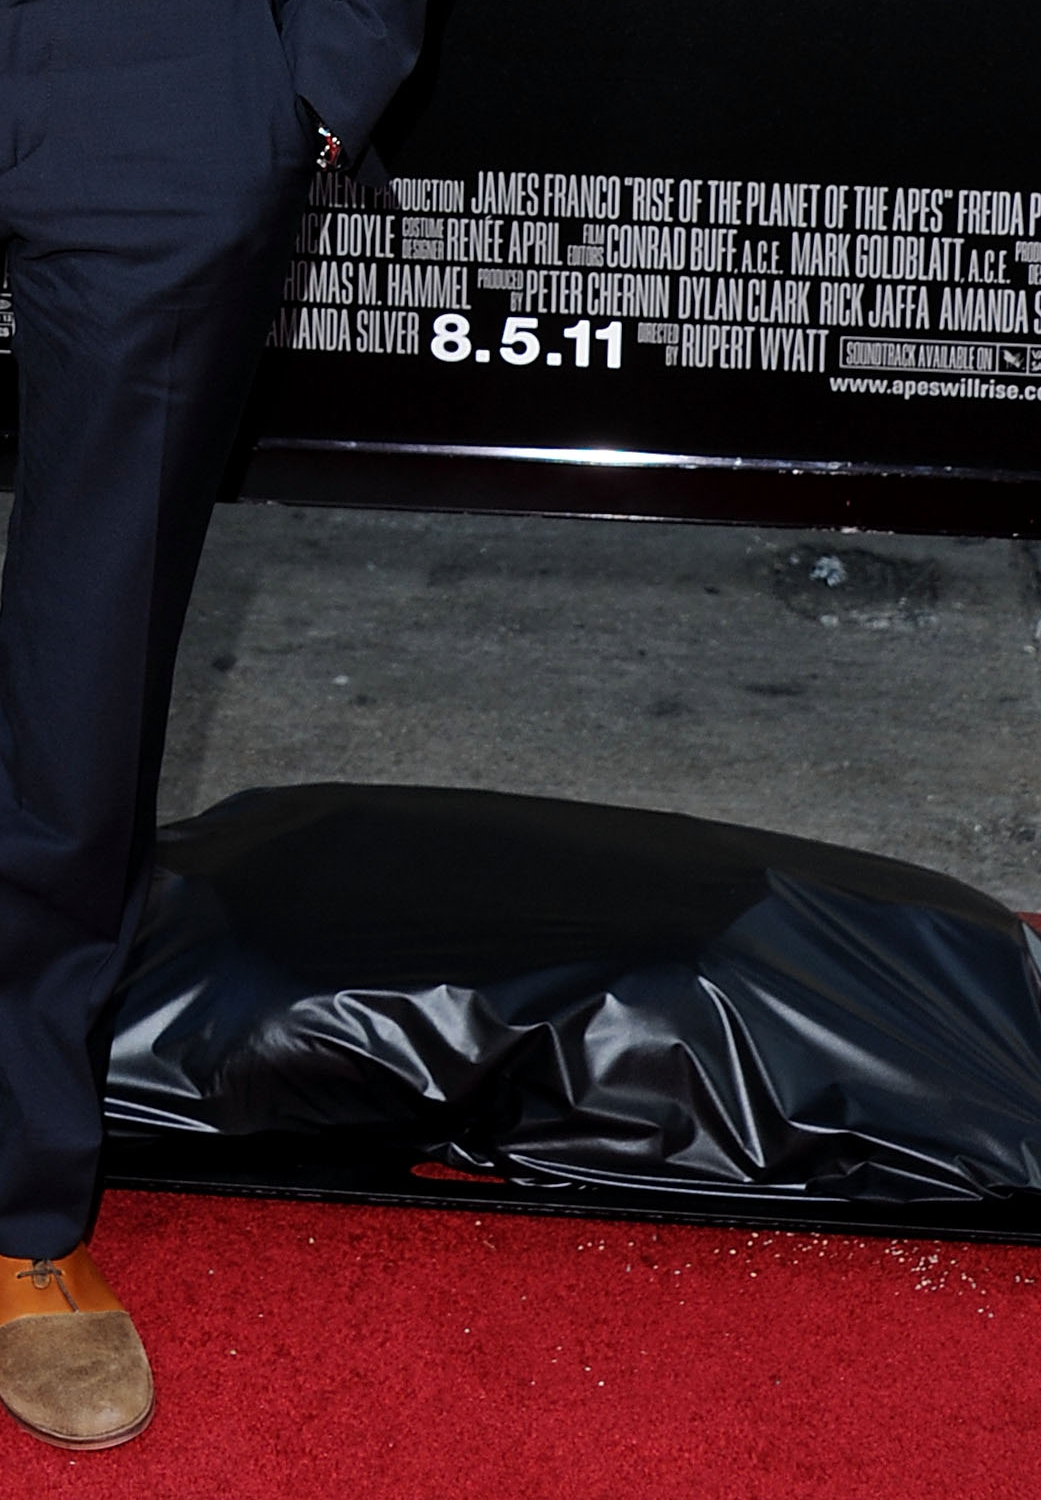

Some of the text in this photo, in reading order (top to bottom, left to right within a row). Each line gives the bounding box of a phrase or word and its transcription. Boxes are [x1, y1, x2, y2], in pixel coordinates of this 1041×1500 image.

[471, 171, 539, 216] JAMES
[543, 173, 621, 220] FRANCO
[624, 177, 674, 222] "RISE
[678, 179, 703, 223] OF
[707, 180, 742, 225] THE
[746, 181, 821, 228] PLANET
[824, 184, 849, 229] OF
[853, 185, 889, 231] THE
[892, 187, 953, 233] APES"
[957, 189, 1025, 236] FREIDA
[337, 213, 395, 258] DOYLE
[402, 217, 444, 238] COSTUME
[447, 215, 563, 265] RENÉE APRIL
[583, 224, 605, 244] FILM
[402, 239, 444, 260] DESIGNER
[567, 245, 604, 267] EDITORS
[606, 224, 686, 270] CONRAD
[690, 227, 738, 274] BUFF,
[741, 240, 784, 275] A.C.E.
[791, 231, 851, 277] MARK
[855, 234, 965, 284] GOLDBLATT,
[968, 249, 1011, 284] A.C.E.
[283, 260, 472, 310] HOMAS M. HAMMEL
[478, 268, 523, 290] PRODUCED
[510, 291, 523, 312] BY
[525, 269, 583, 315] PETER
[587, 272, 670, 319] CHERNIN
[678, 276, 744, 322] DYLAN
[747, 278, 811, 325] CLARK
[819, 281, 865, 327] RICK
[868, 284, 930, 330] JAFFA
[939, 286, 1029, 334] AMANDA
[356, 309, 420, 355] SILVER
[430, 313, 622, 369] 8.5.11
[637, 322, 680, 344] DIRECTED
[665, 345, 679, 366] BY
[681, 323, 829, 373] RUPERT WYATT
[846, 341, 993, 371] SOUNDTRACK AVAILABLE ON
[829, 376, 1041, 401] www.apeswillrise.c
